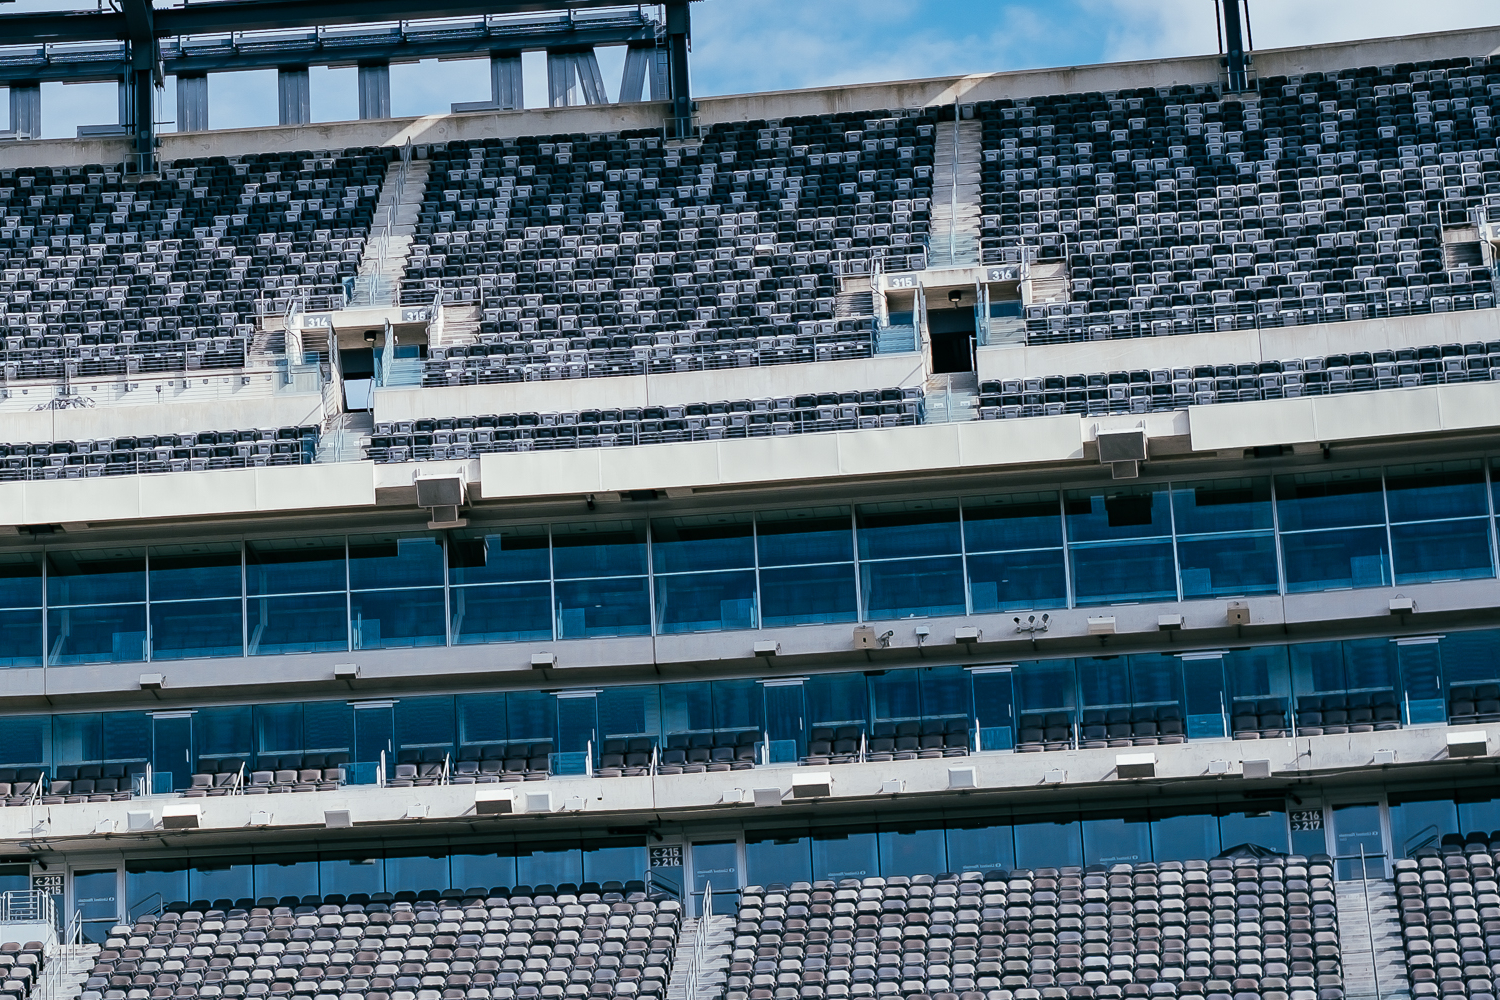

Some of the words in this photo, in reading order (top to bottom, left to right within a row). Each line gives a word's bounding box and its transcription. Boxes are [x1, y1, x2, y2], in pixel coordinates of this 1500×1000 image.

[992, 270, 1012, 280] 316
[893, 277, 912, 288] 315
[308, 317, 328, 327] 314
[1301, 811, 1320, 820] 216
[1302, 821, 1320, 830] 217
[661, 847, 680, 857] 215
[662, 857, 680, 867] 216
[44, 876, 61, 885] 213
